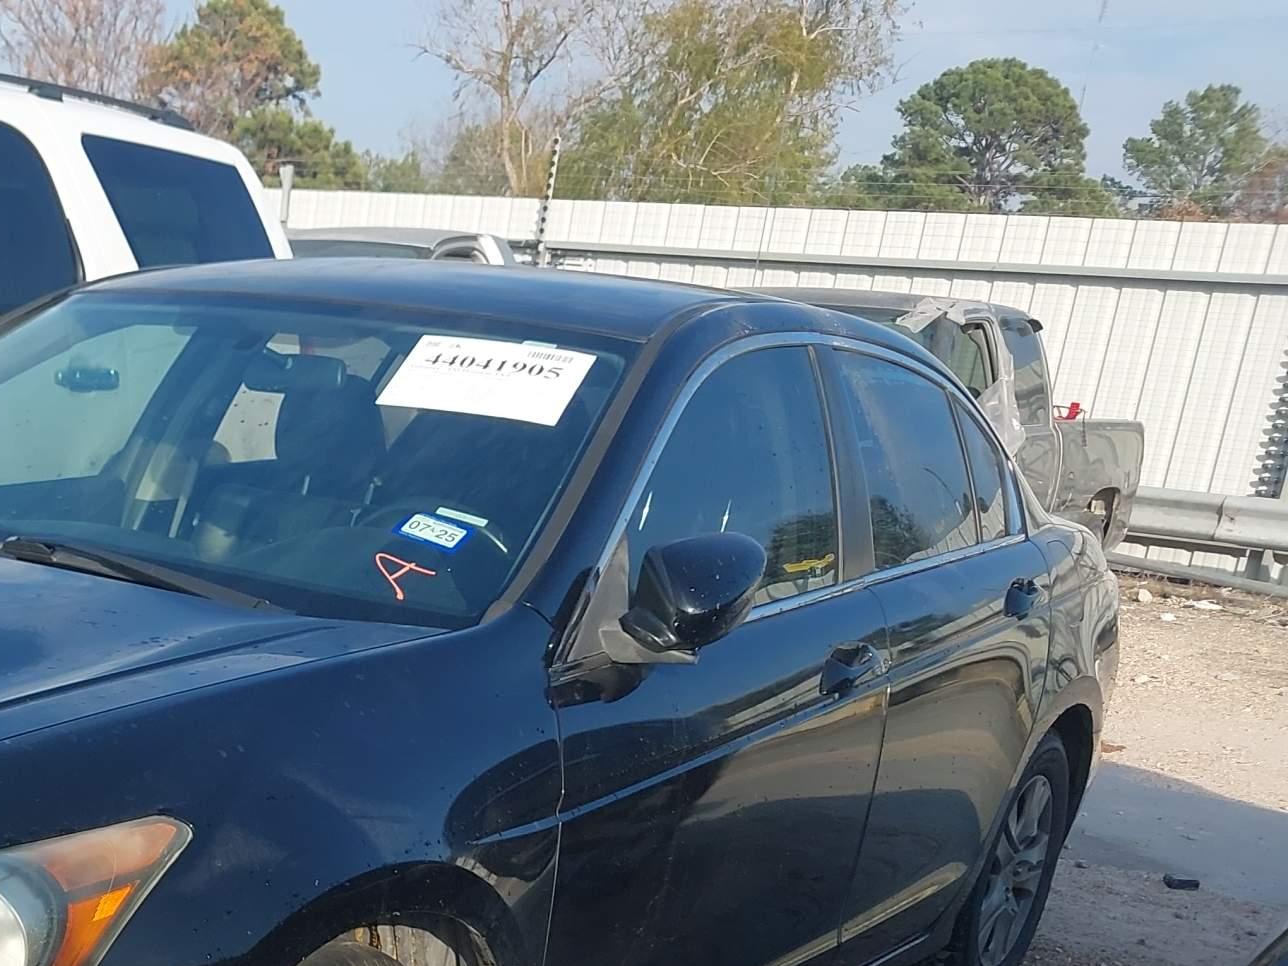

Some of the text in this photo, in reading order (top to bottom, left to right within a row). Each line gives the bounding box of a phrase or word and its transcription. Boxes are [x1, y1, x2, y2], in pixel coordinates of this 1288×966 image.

[424, 352, 564, 380] 44041905
[408, 520, 460, 544] 07 25
[375, 552, 437, 601] A
